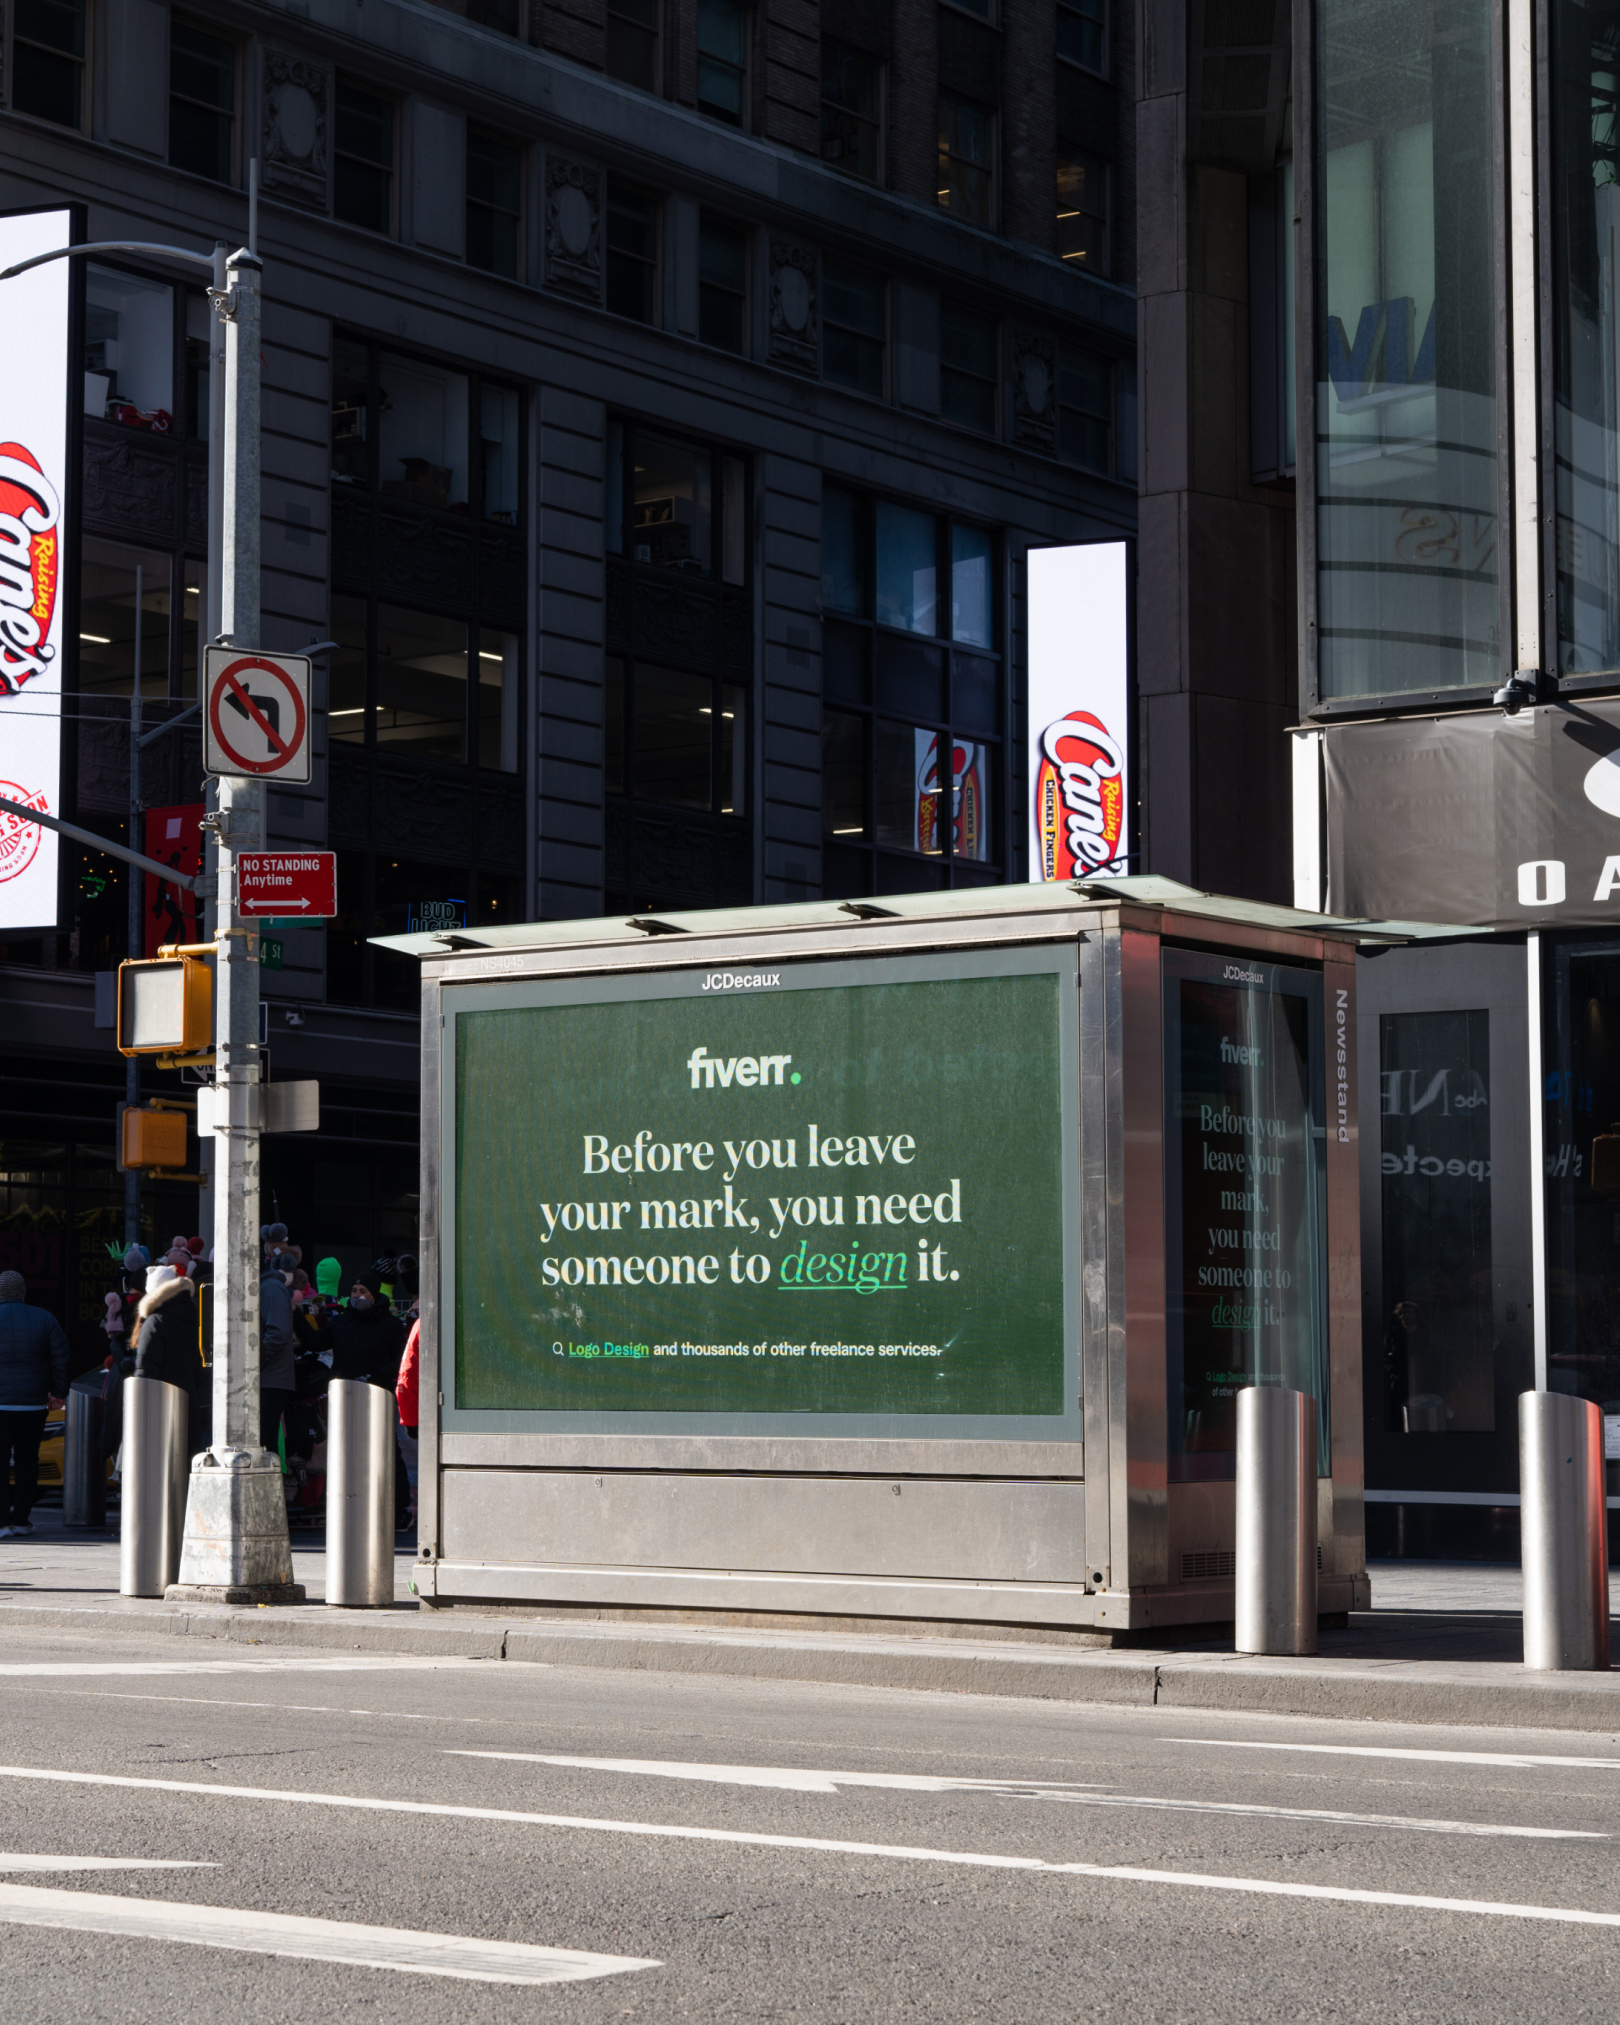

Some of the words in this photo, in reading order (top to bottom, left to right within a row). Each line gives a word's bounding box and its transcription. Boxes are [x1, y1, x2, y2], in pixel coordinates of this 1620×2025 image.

[33, 536, 54, 619] Raising
[1045, 780, 1055, 827] CHICKEN
[1103, 780, 1120, 842] Raising
[243, 859, 260, 872] NO
[262, 859, 320, 872] STANDING
[1045, 831, 1056, 879] FINGERS
[243, 874, 293, 889] Anytime
[420, 901, 456, 921] BUD
[272, 944, 281, 959] St
[701, 971, 781, 991] JCDecaux
[1223, 965, 1264, 984] JCDecaux
[687, 1046, 802, 1090] fiverr.
[1336, 989, 1350, 1143] Newsstand
[1200, 1104, 1254, 1135] Before
[1258, 1117, 1287, 1144] you
[583, 1130, 715, 1175] Before
[722, 1138, 798, 1181] you
[808, 1125, 917, 1168] leave
[1203, 1142, 1245, 1172] leave
[1248, 1154, 1285, 1180] your
[540, 1199, 631, 1243] your
[640, 1186, 760, 1235] mark,
[769, 1195, 844, 1239] you
[855, 1180, 963, 1226] need
[1221, 1187, 1269, 1216] mark,
[1208, 1226, 1239, 1255] you
[1242, 1224, 1281, 1250] need
[541, 1252, 720, 1287] someone
[730, 1246, 771, 1284] to
[779, 1240, 908, 1295] design
[917, 1239, 960, 1283] it.
[1198, 1264, 1272, 1287] someone
[1276, 1266, 1291, 1289] to
[1211, 1297, 1261, 1332] design
[1263, 1298, 1280, 1325] it.
[568, 1341, 600, 1358] Logo
[603, 1341, 650, 1358] Design
[653, 1341, 677, 1355] and
[681, 1341, 749, 1356] thousands
[752, 1341, 767, 1356] of
[770, 1341, 806, 1356] other
[810, 1341, 874, 1356] freelance
[878, 1341, 942, 1357] services.
[1227, 1372, 1246, 1383] Design
